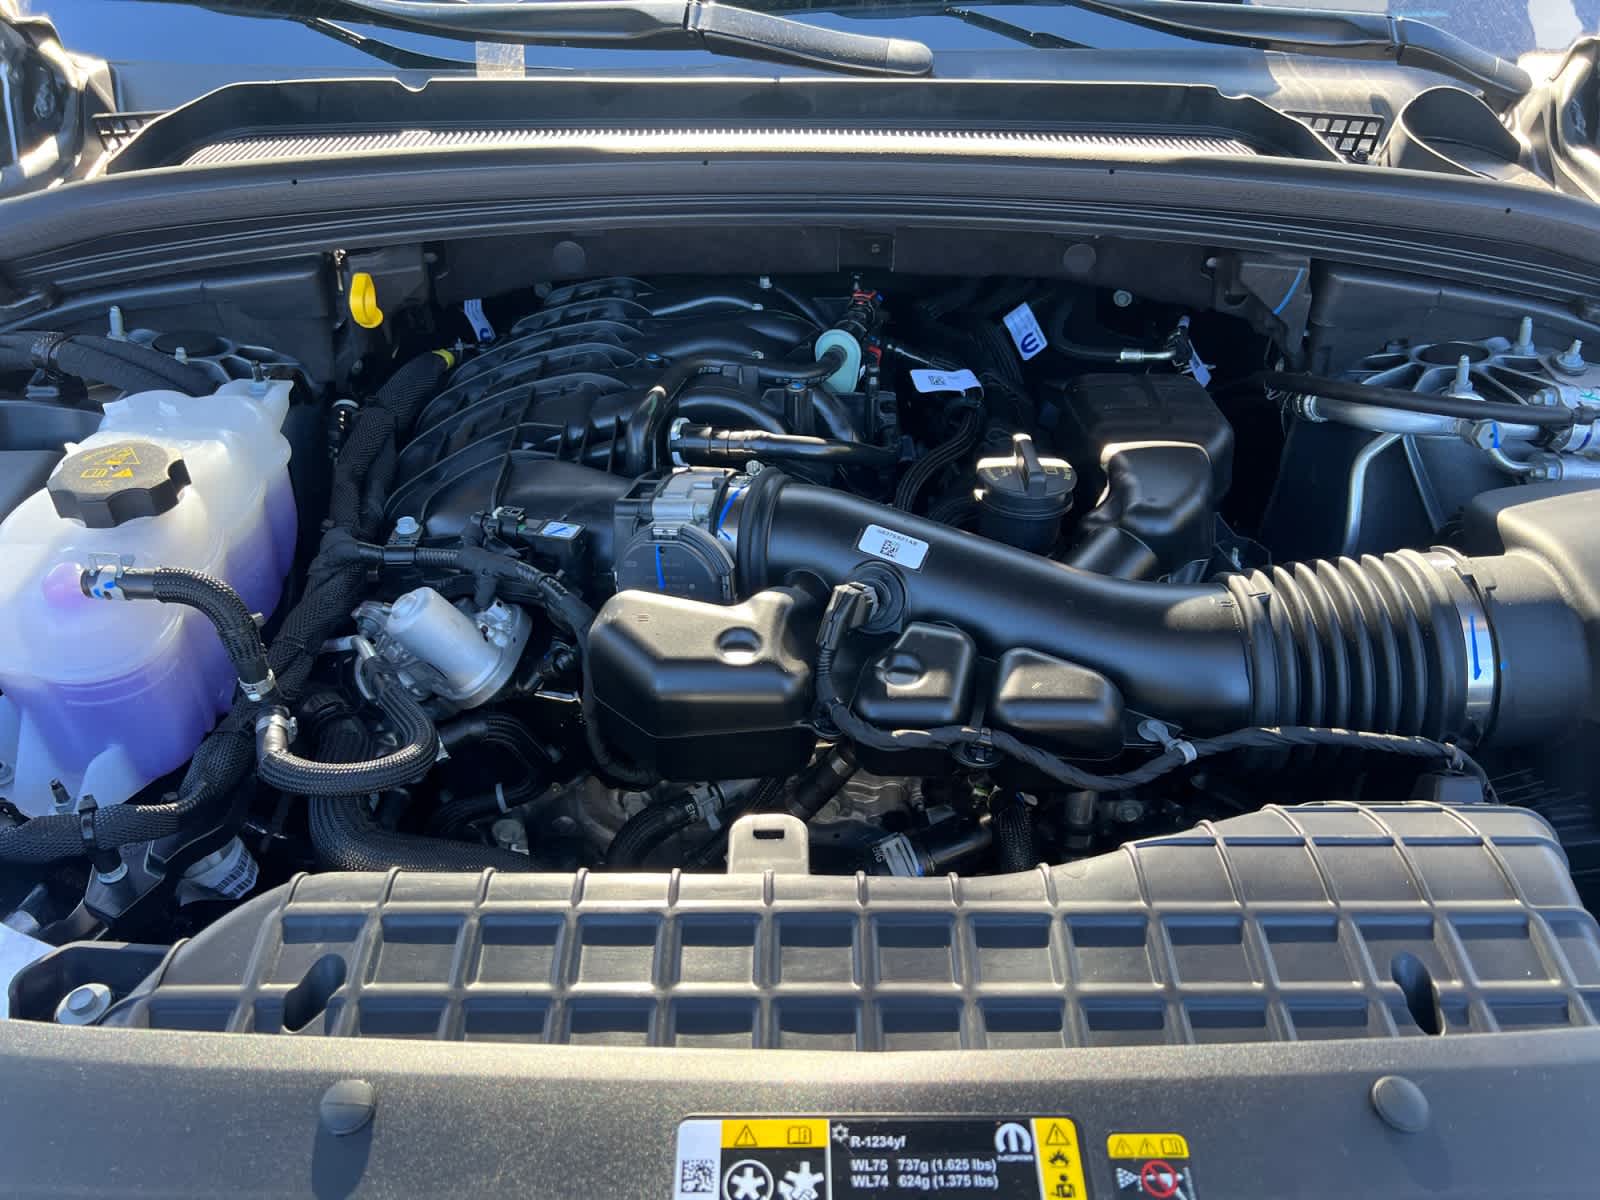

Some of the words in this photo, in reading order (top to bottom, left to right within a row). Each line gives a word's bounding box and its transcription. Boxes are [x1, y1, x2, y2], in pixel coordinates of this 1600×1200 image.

[850, 1135, 906, 1150] R-1234yf
[850, 1158, 888, 1172] WL75
[897, 1158, 929, 1174] 737g
[931, 1158, 970, 1173] (1.625
[971, 1158, 997, 1173] lbs)
[851, 1174, 889, 1188] WL74
[898, 1174, 931, 1190] 624g
[932, 1174, 972, 1190] (1.375
[973, 1174, 999, 1190] lbs)
